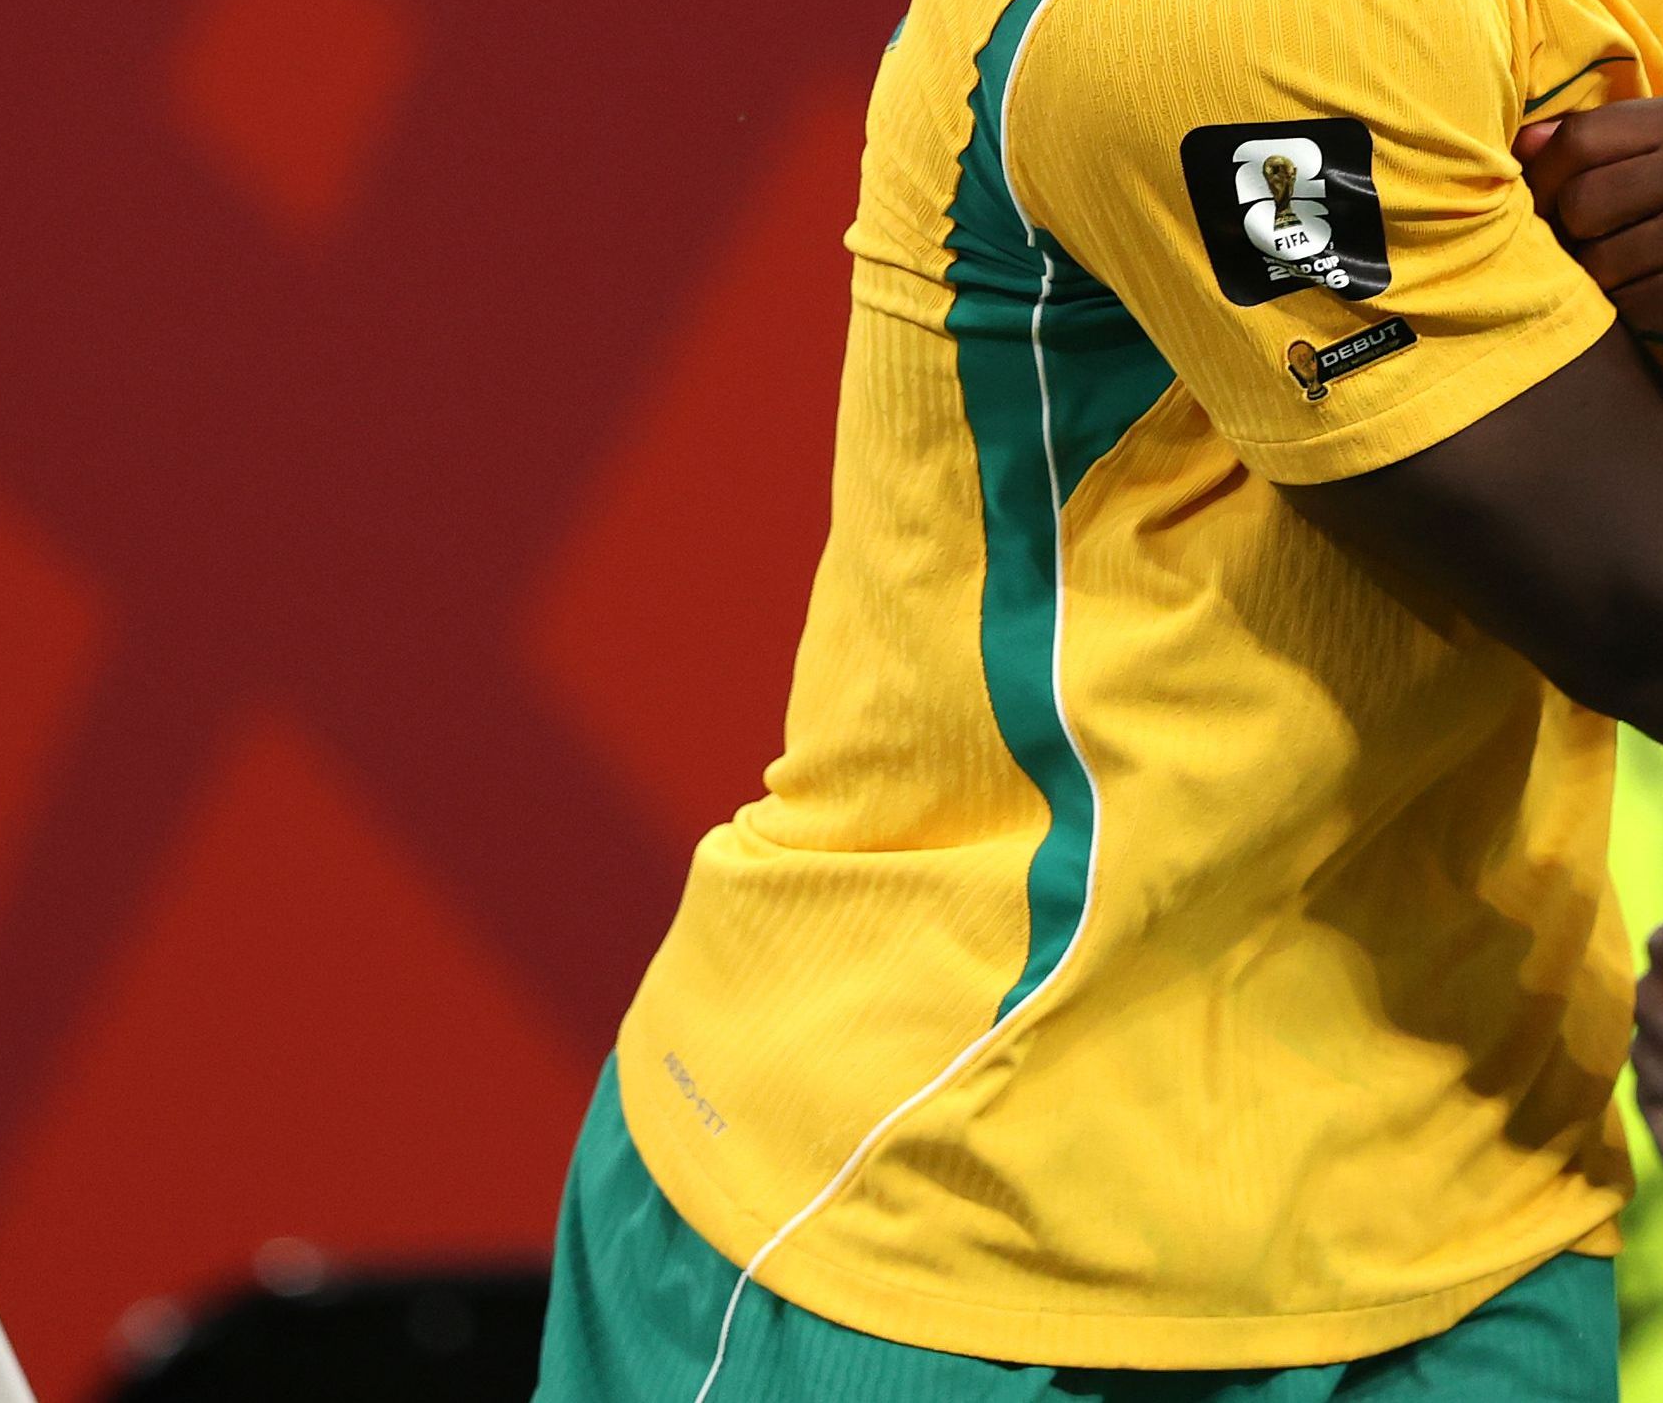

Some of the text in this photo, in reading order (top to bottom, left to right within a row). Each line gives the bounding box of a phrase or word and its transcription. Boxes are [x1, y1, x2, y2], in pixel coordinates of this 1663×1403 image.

[1274, 231, 1310, 252] FIFA
[1313, 255, 1340, 272] CUP
[1320, 322, 1398, 368] DEBUT
